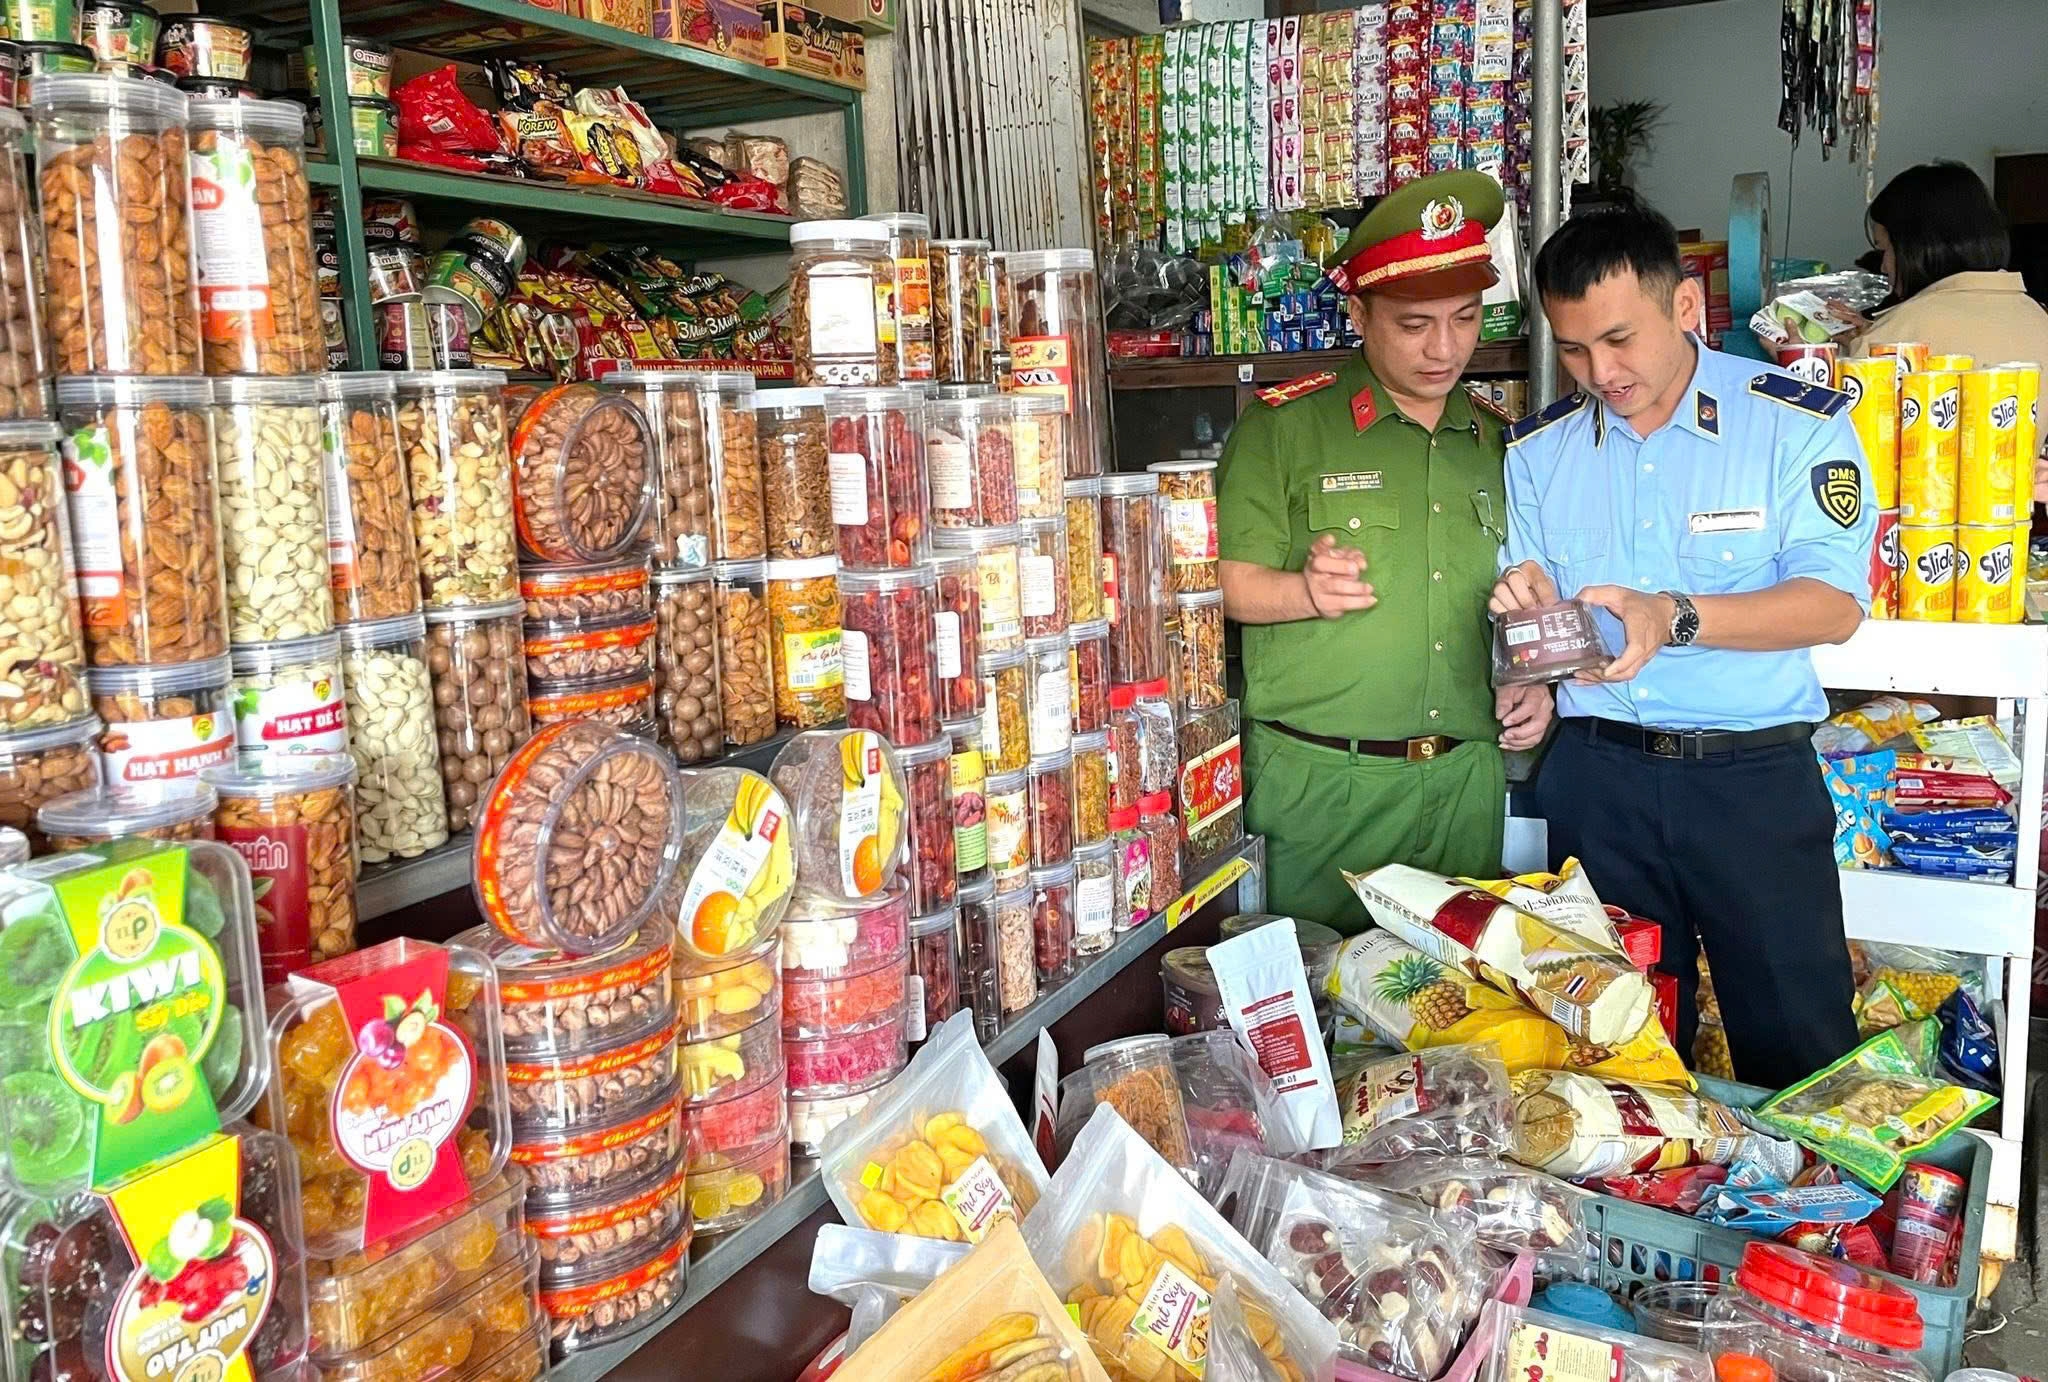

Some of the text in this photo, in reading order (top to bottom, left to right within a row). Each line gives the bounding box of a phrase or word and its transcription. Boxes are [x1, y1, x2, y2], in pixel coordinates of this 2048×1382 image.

[518, 118, 557, 133] KORENO
[706, 318, 717, 334] 3
[1828, 468, 1856, 480] DMS
[71, 951, 201, 1028] KIWI
